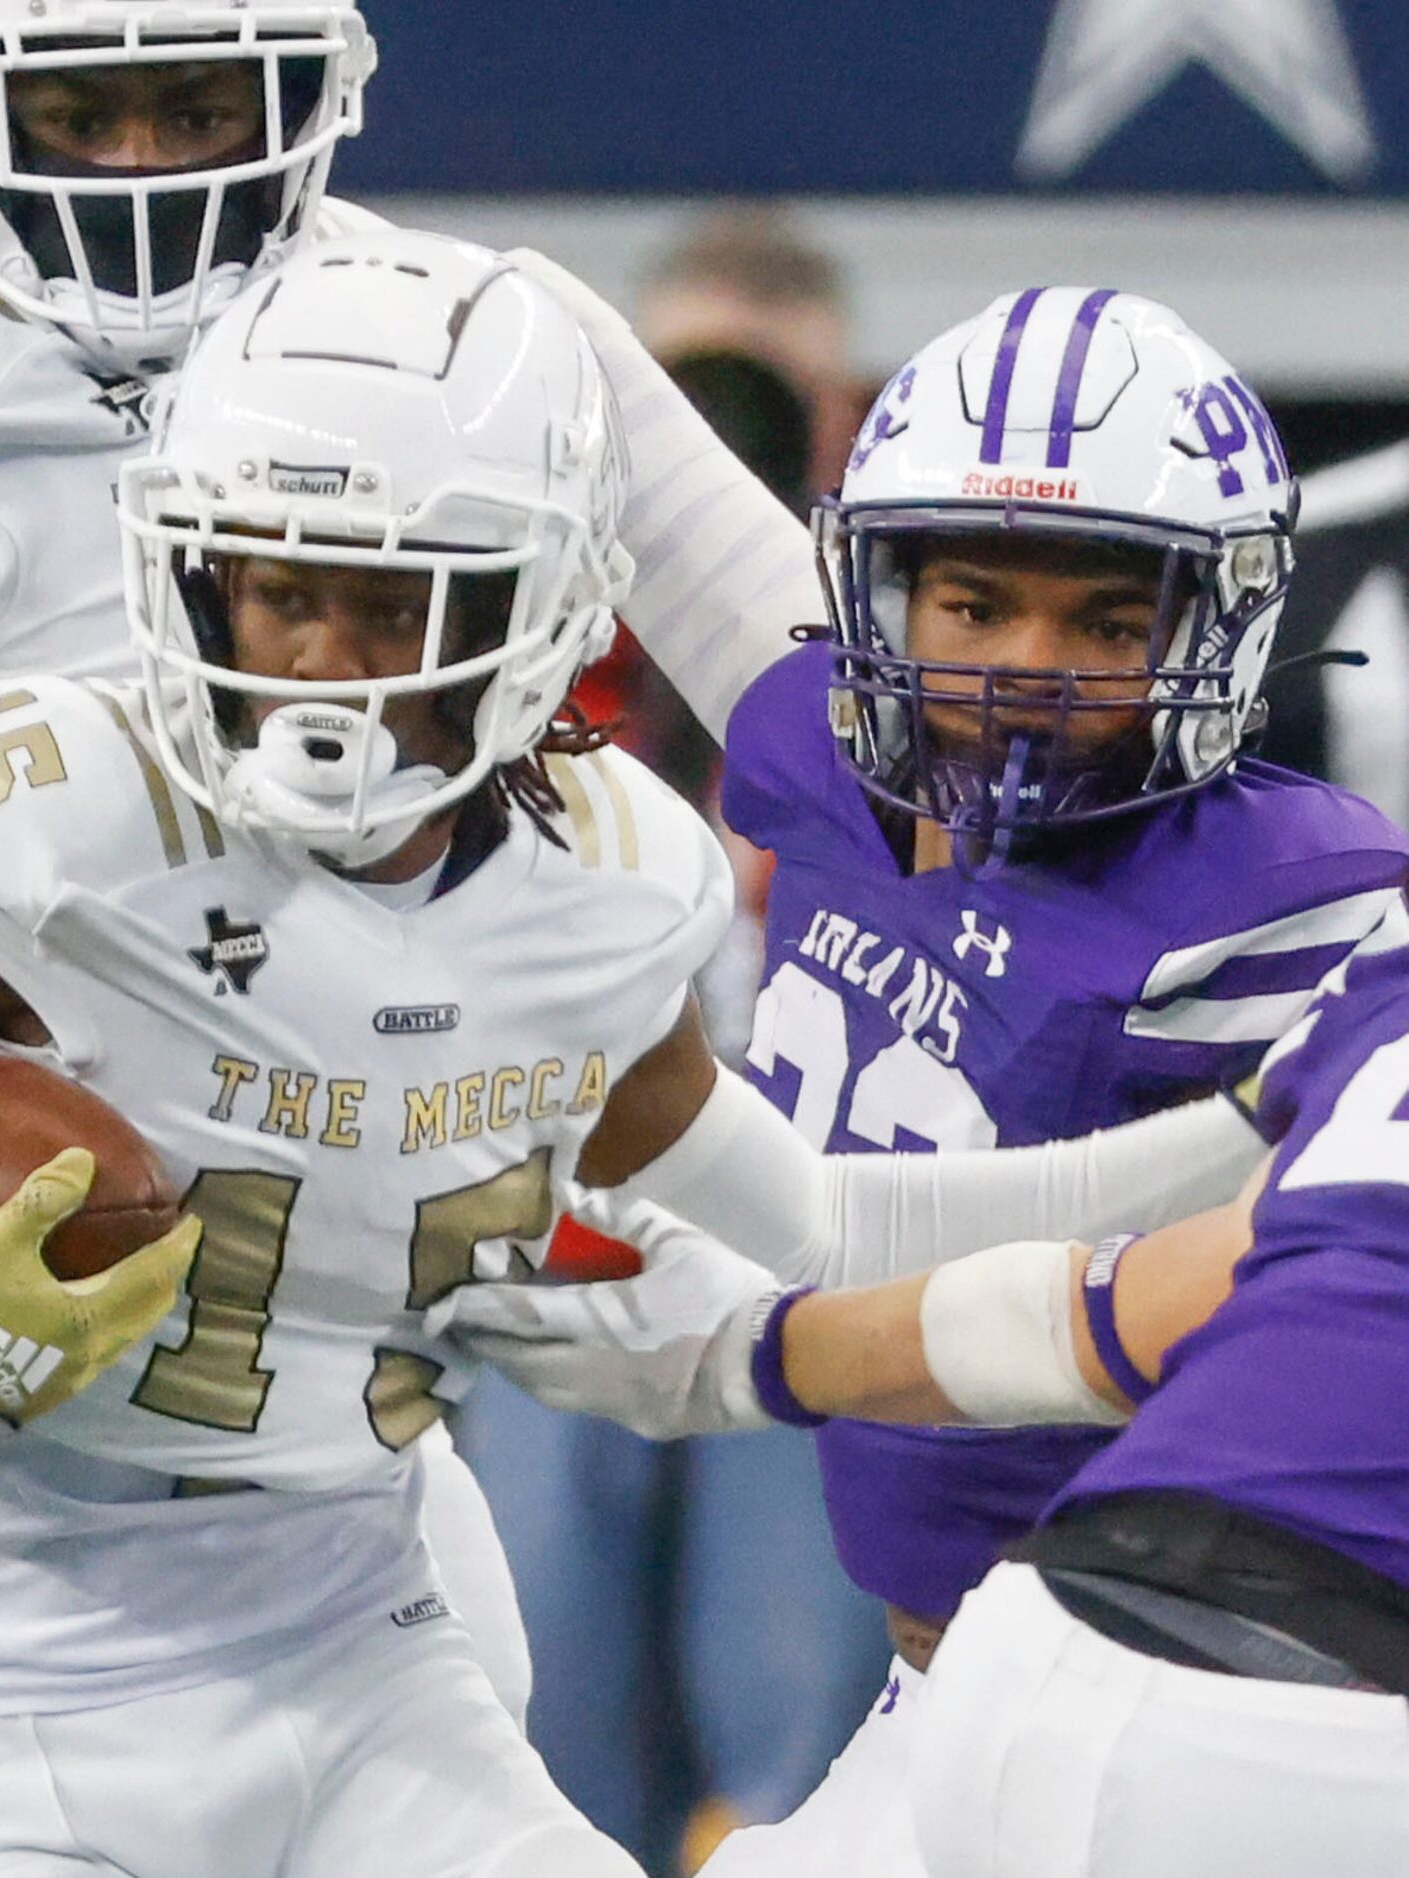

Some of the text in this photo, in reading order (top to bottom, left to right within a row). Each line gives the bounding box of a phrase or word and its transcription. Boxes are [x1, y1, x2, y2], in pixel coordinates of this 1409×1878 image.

[961, 473, 1078, 501] Riddell
[382, 1010, 457, 1031] BATTLE
[208, 1050, 608, 1156] THE MECCA
